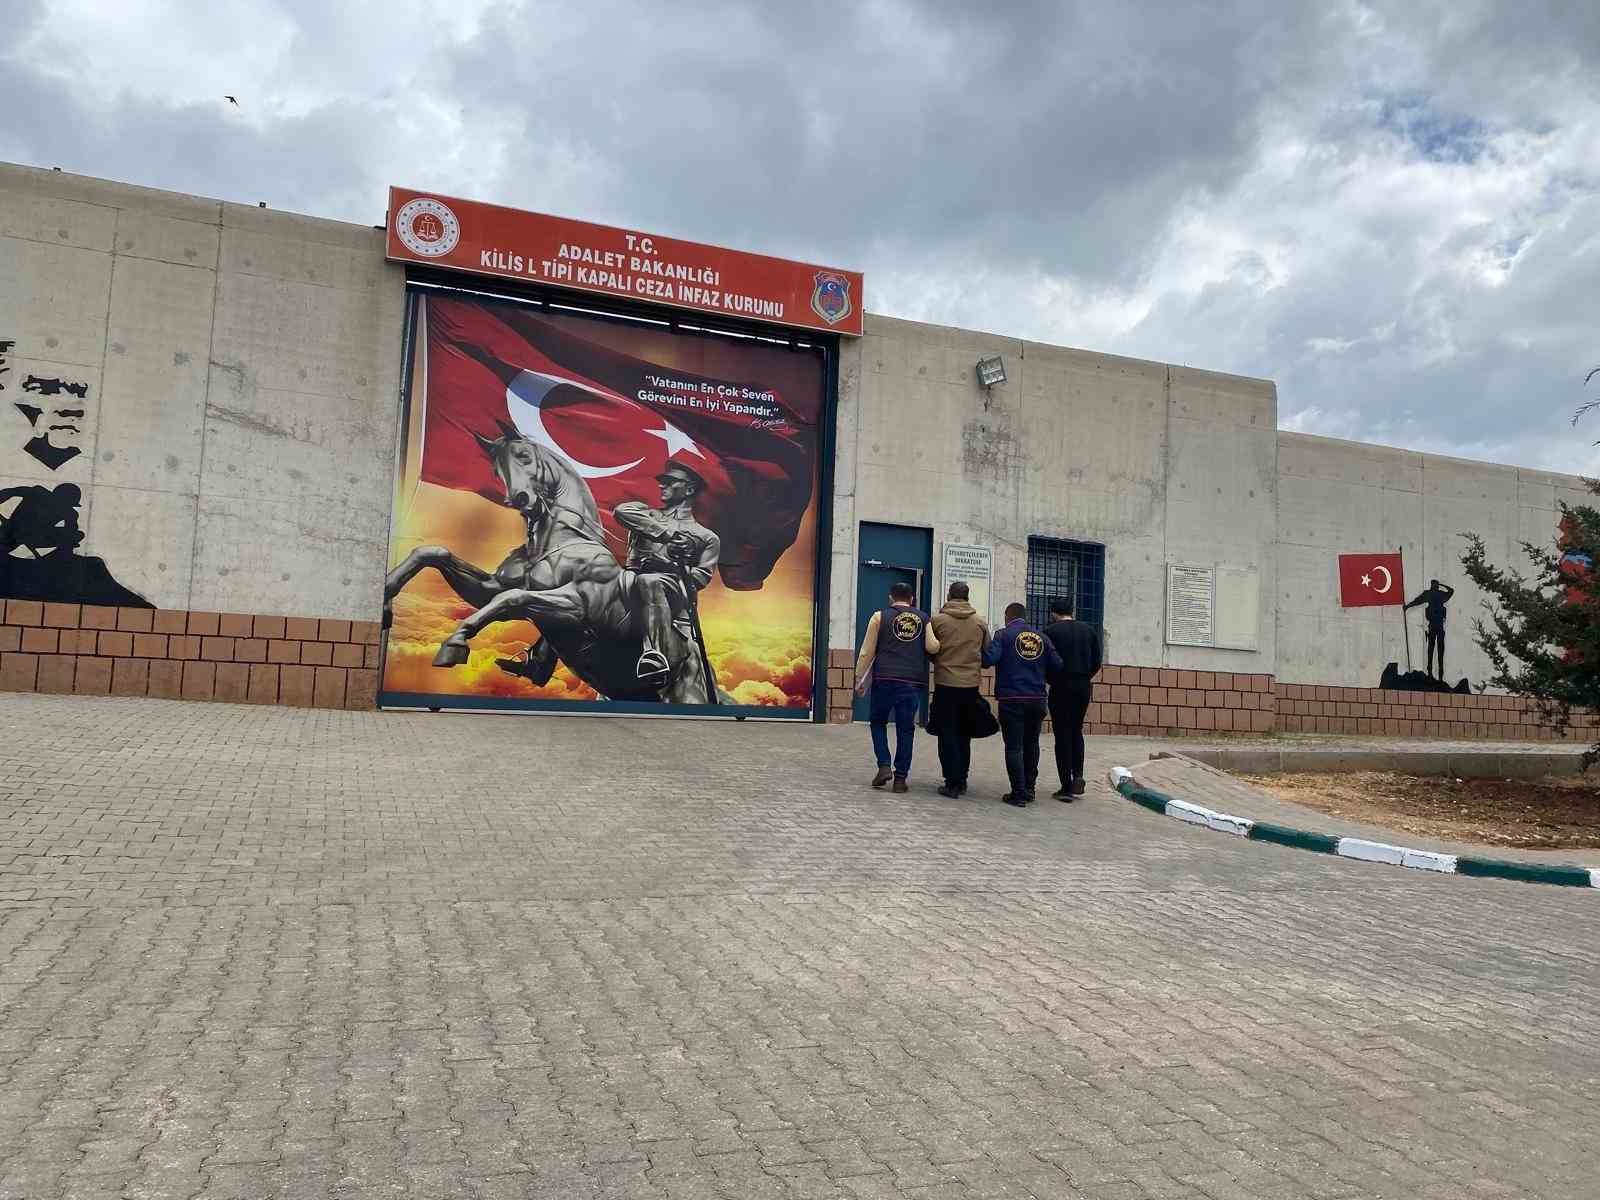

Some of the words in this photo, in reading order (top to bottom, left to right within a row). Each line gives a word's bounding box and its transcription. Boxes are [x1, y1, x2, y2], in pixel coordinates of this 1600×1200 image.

[626, 234, 658, 255] T.C.
[558, 243, 625, 268] ADALET
[630, 256, 720, 285] BAKANLIĞI
[480, 248, 523, 272] KİLİS
[528, 258, 537, 274] L
[542, 259, 572, 280] TİPİ
[577, 266, 631, 291] KAPALI
[635, 277, 674, 298] CEZA
[678, 281, 720, 307] İNFAZ
[723, 292, 784, 317] KURUMU
[637, 390, 687, 406] Görevini
[689, 398, 703, 408] En
[706, 397, 720, 411] İyi
[701, 383, 714, 394] En
[717, 385, 739, 399] Çok
[741, 388, 775, 402] Seven
